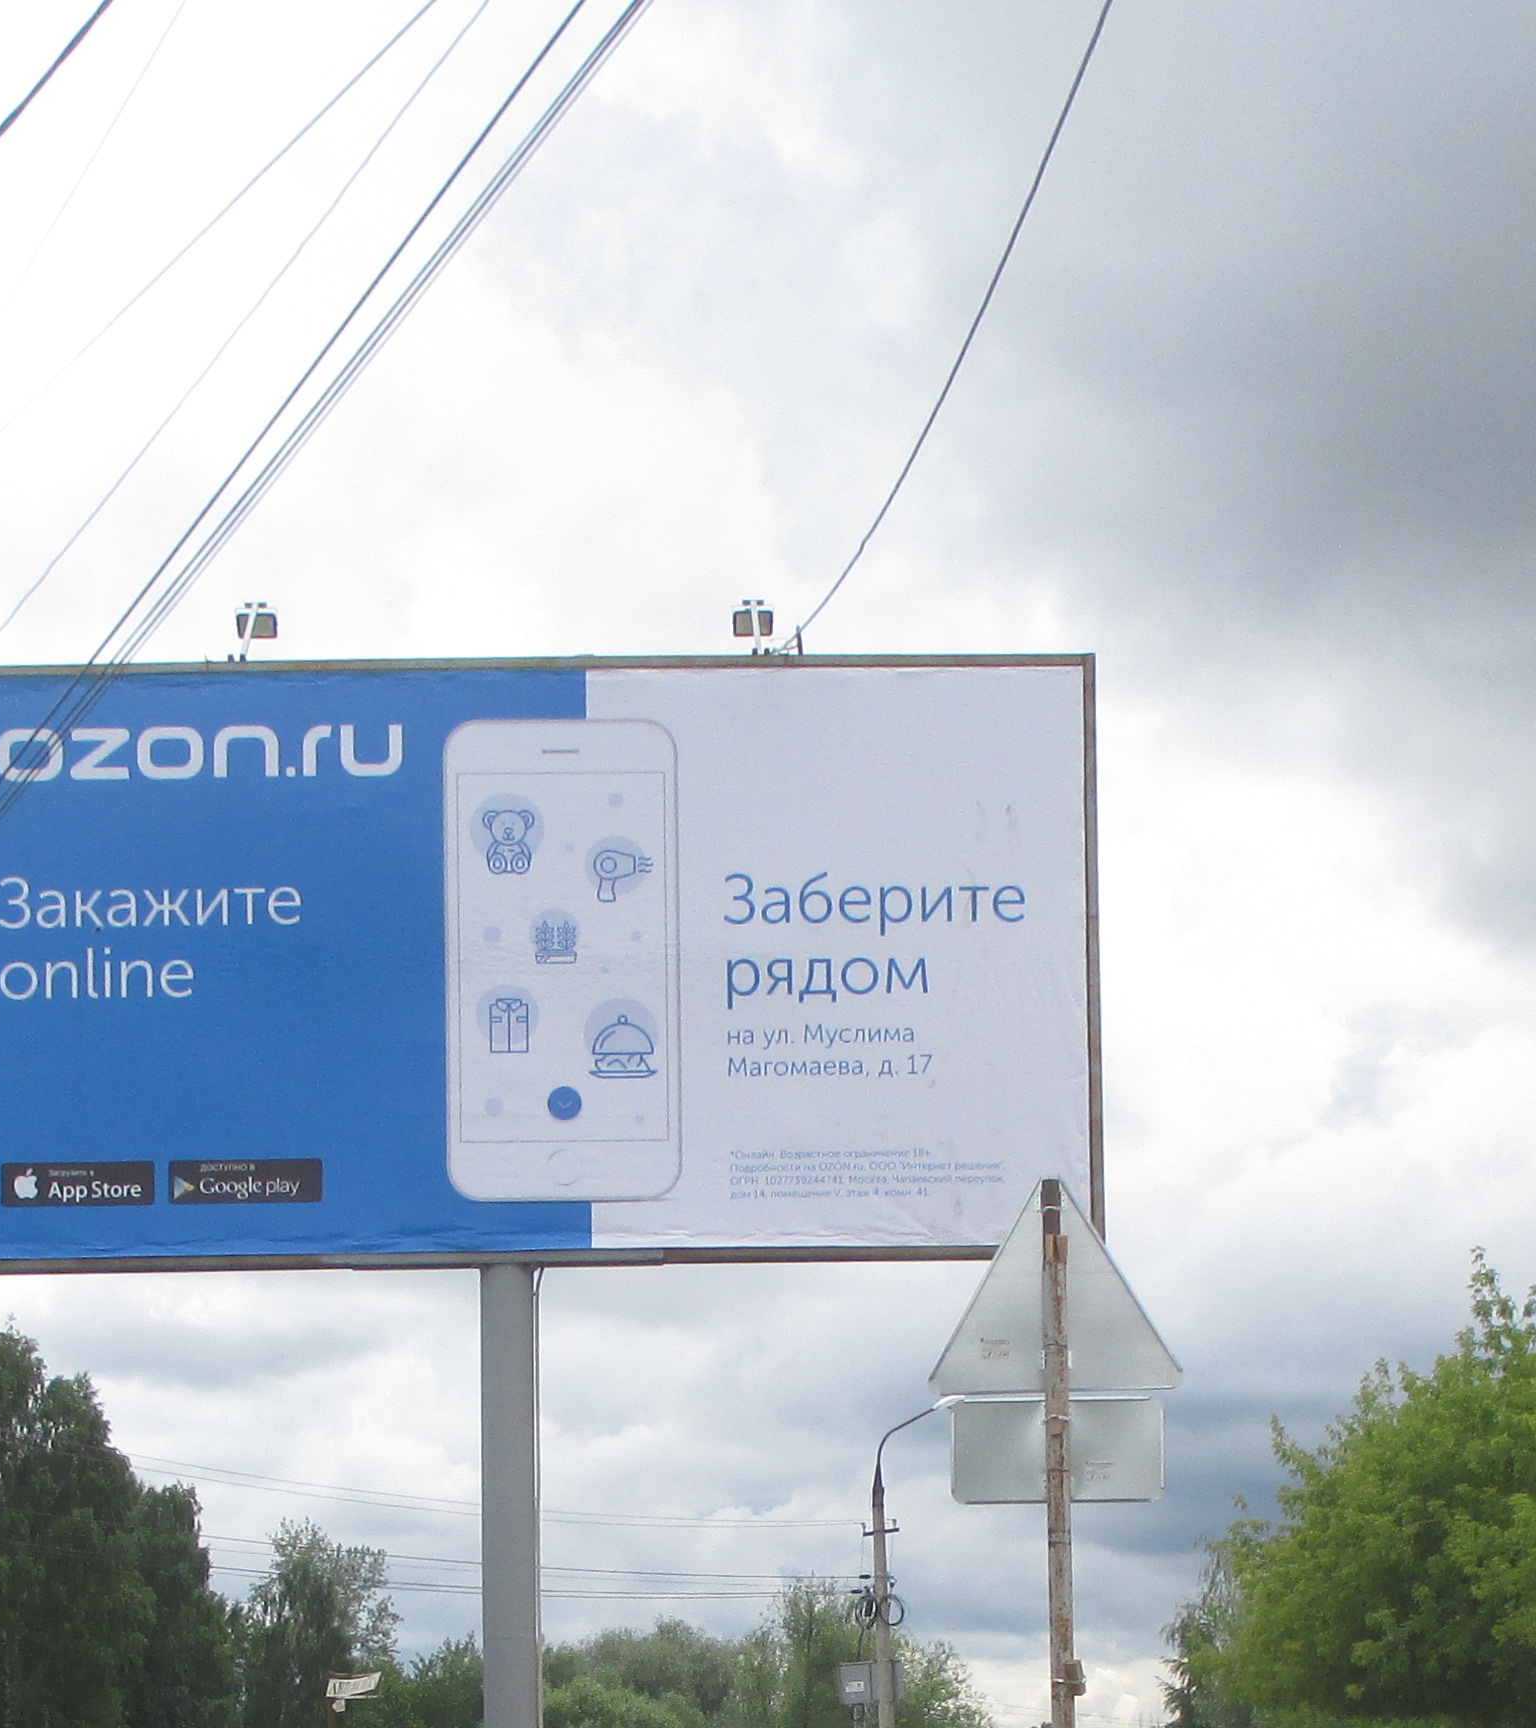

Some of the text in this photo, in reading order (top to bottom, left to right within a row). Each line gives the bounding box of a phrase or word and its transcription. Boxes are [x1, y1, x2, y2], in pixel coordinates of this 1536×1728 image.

[723, 871, 1026, 937] Заберите
[725, 956, 930, 1011] рядом
[726, 1023, 916, 1050] на ул. Муслима
[726, 1054, 933, 1078] Магомаева, д. 17
[868, 1161, 897, 1171] ООО
[47, 1180, 143, 1203] App Store
[199, 1175, 301, 1200] Google play
